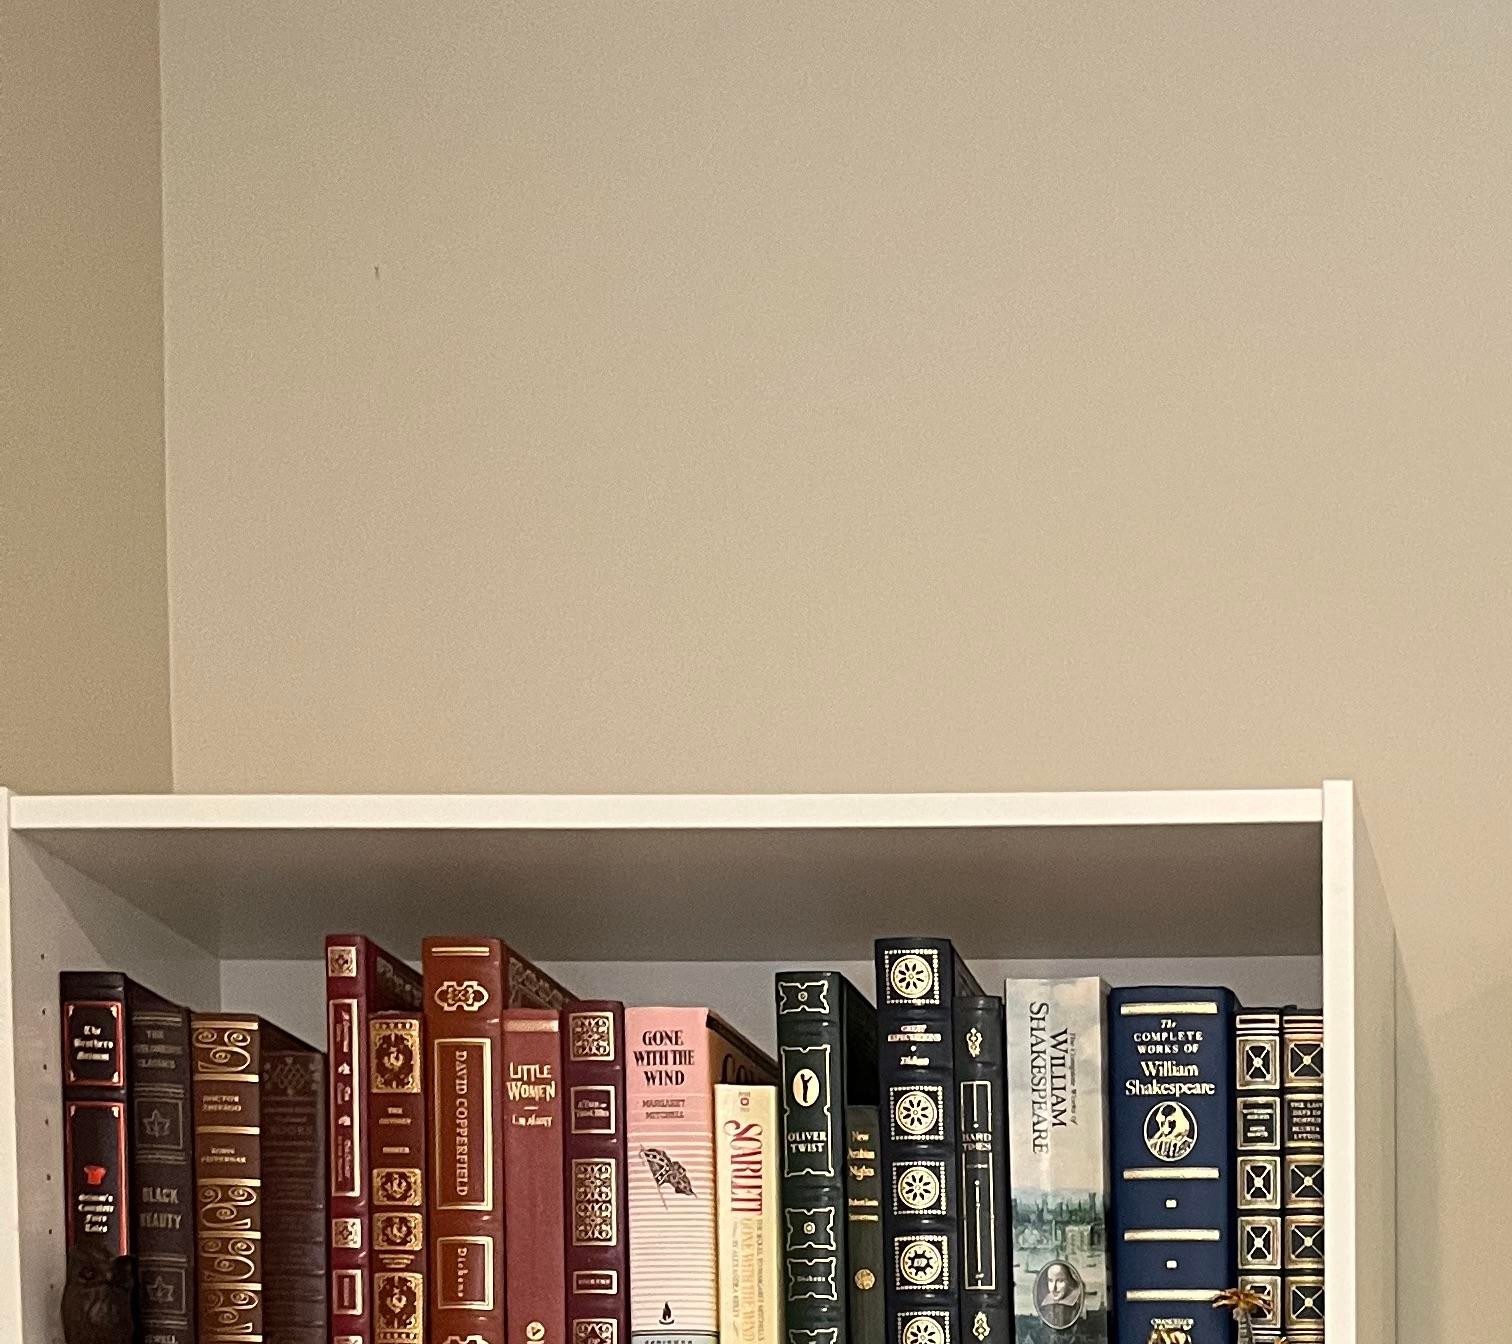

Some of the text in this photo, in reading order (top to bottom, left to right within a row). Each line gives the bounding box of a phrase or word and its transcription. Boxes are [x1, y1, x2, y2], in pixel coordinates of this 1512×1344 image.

[1160, 1018, 1176, 1028] The
[642, 1031, 683, 1048] GONE
[1134, 1031, 1203, 1042] COMPLETE
[634, 1049, 694, 1067] WITH THE
[1138, 1044, 1199, 1054] WORKS OF
[509, 1062, 551, 1082] LITTLE
[644, 1068, 685, 1086] WIND
[1030, 1002, 1048, 1154] SHAKESPEARE
[1051, 1028, 1068, 1128] WILLIAM
[1141, 1062, 1198, 1078] William
[507, 1079, 556, 1102] WOMEN
[1125, 1079, 1215, 1097] Shakespeare
[456, 1050, 467, 1197] DAVID COPPERFIELD
[788, 1132, 826, 1142] OLIVER
[790, 1143, 824, 1154] TWIST
[457, 1247, 469, 1297] Dickens
